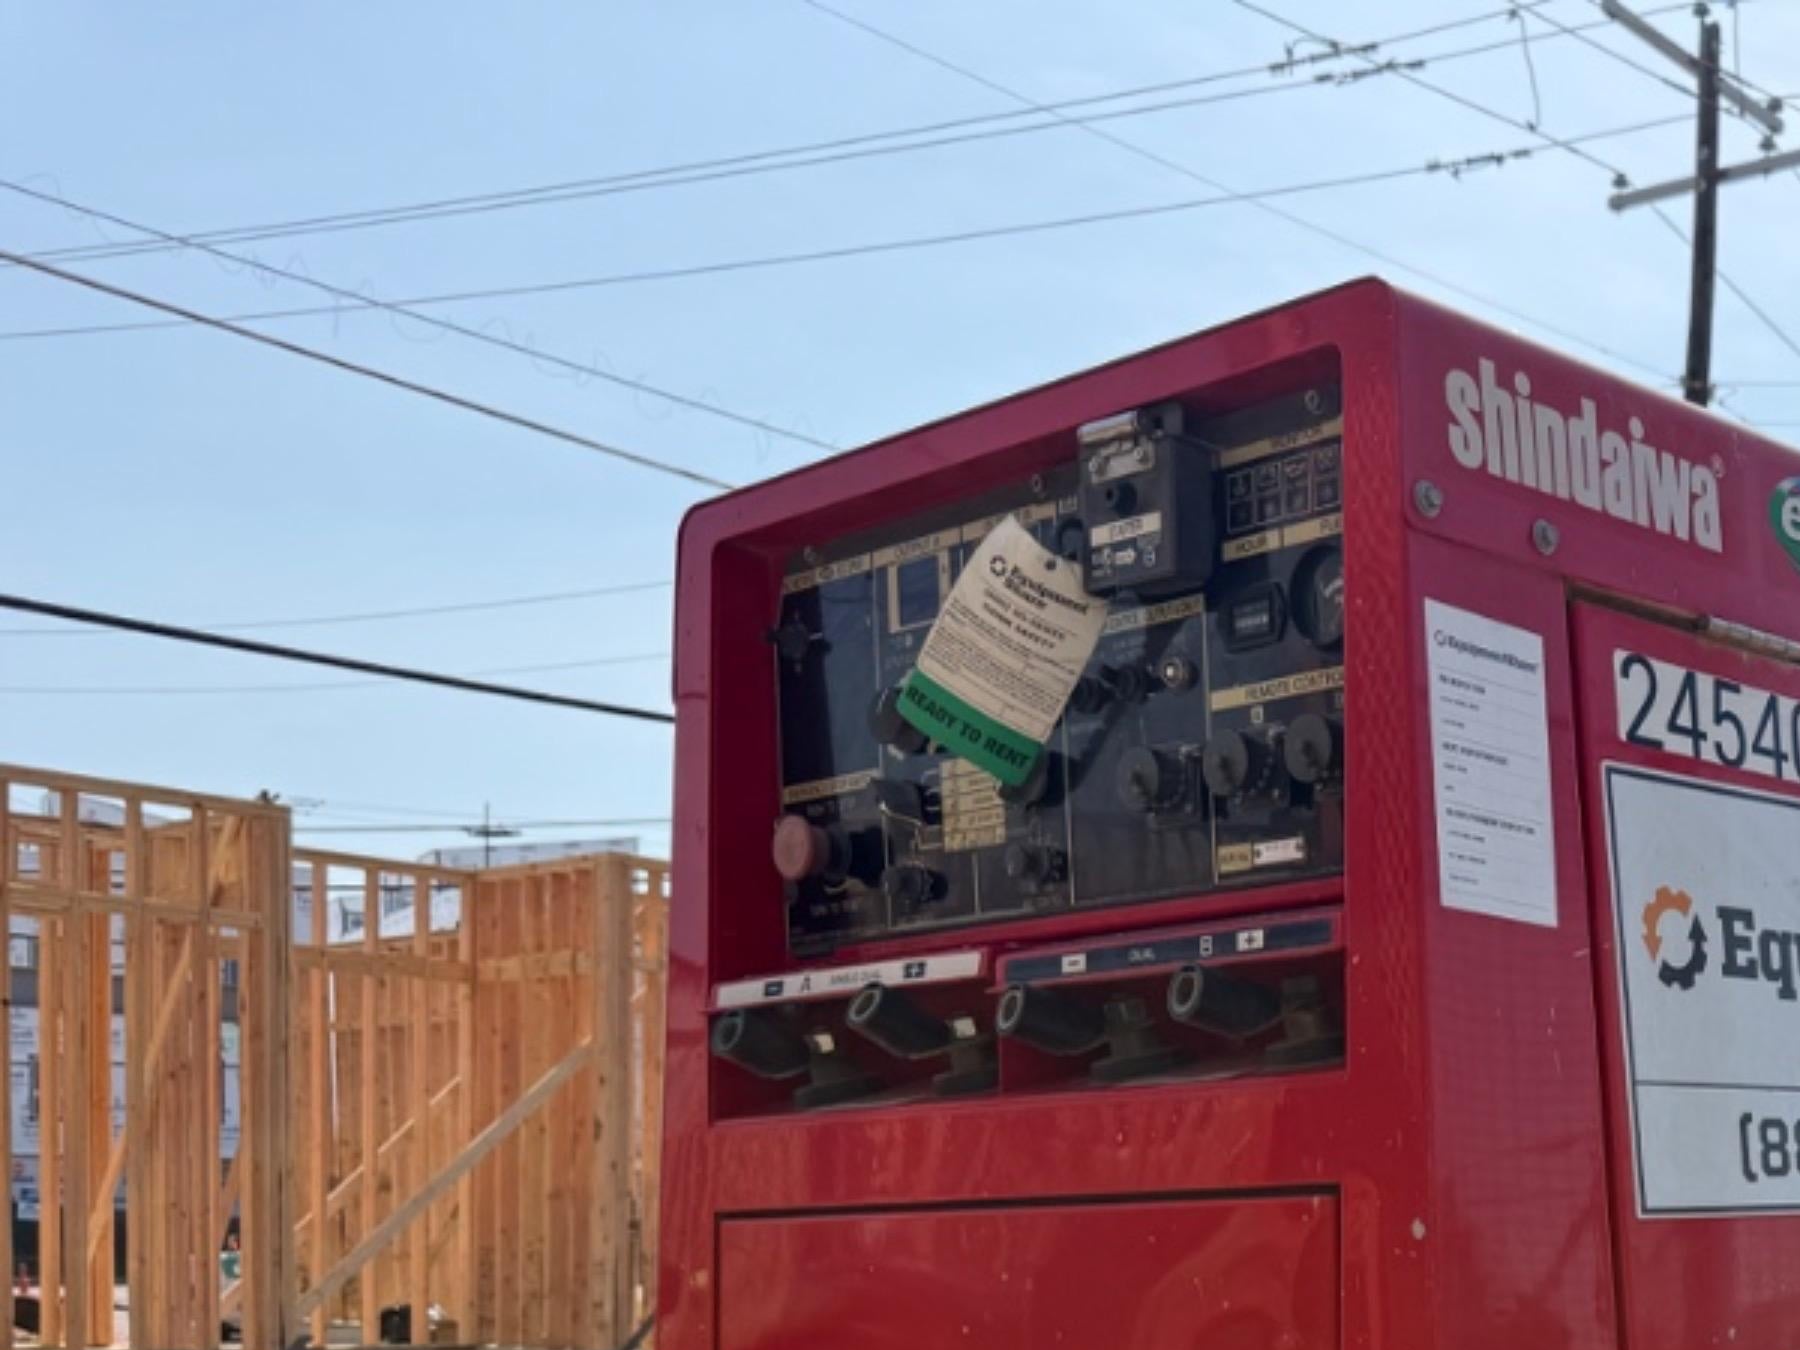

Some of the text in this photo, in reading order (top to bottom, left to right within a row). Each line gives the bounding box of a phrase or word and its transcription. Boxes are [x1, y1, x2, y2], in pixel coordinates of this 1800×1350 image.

[1446, 357, 1723, 552] shindaiwa
[906, 685, 1029, 769] READY TO RENT
